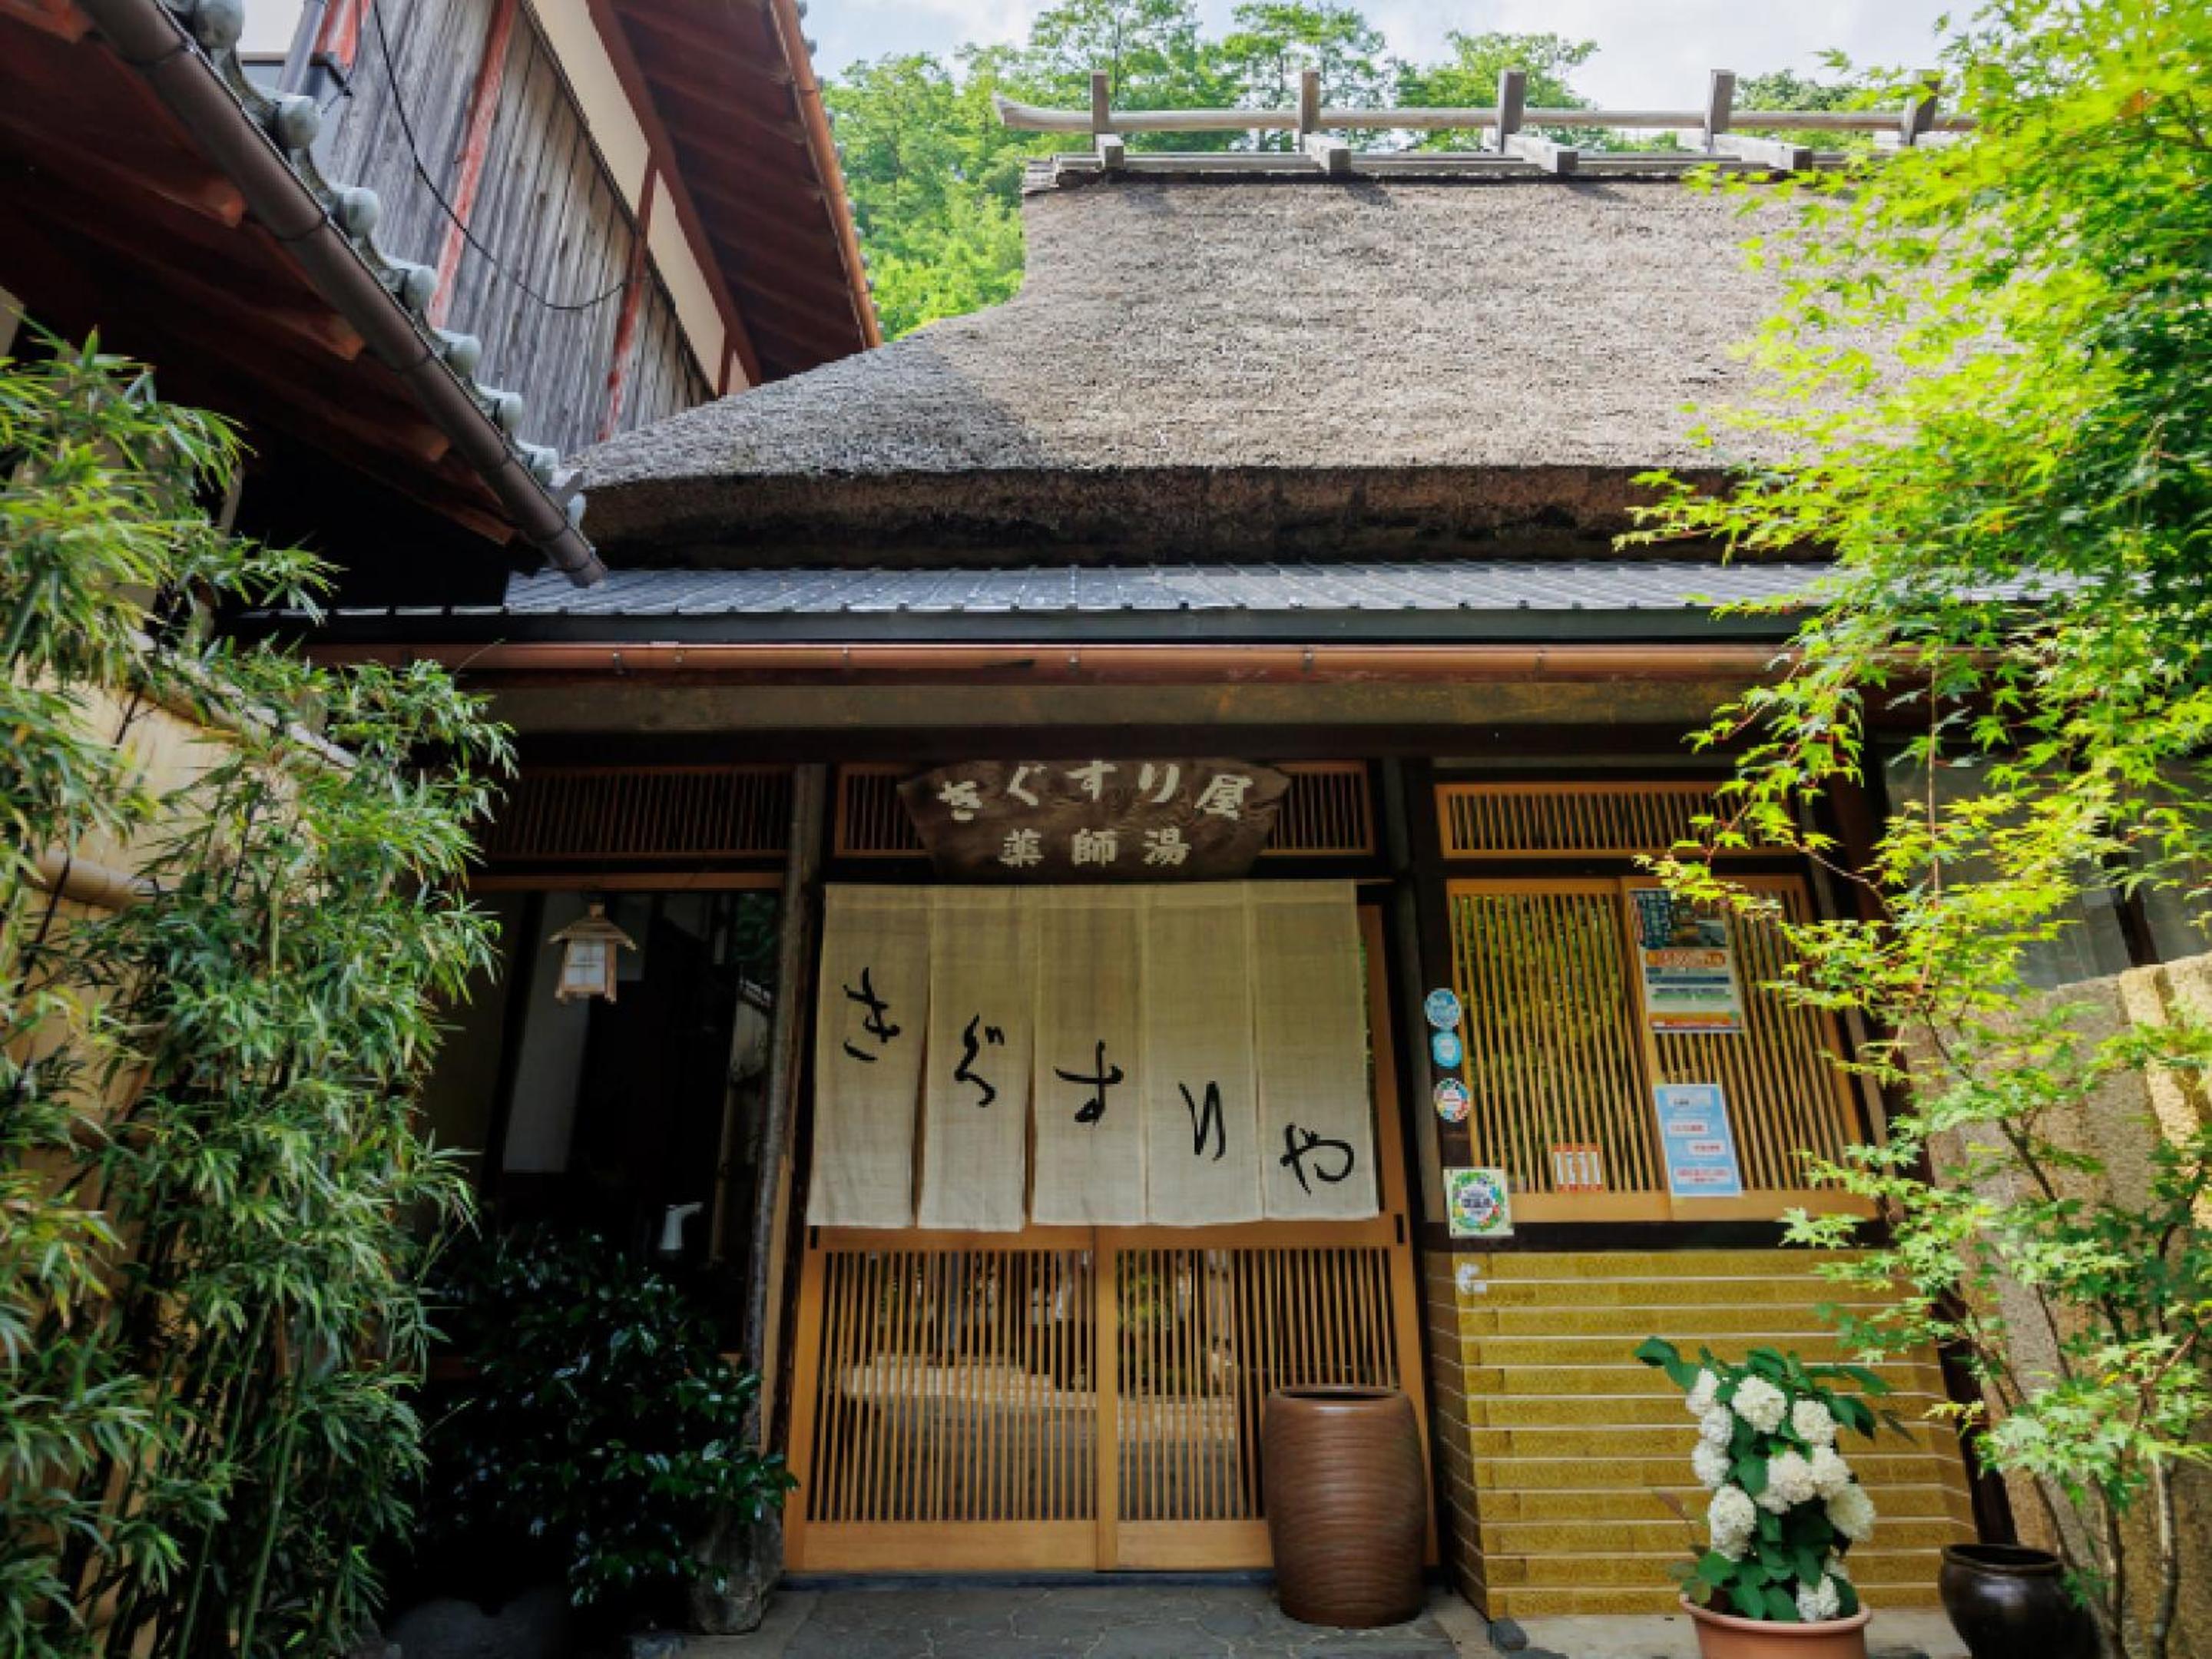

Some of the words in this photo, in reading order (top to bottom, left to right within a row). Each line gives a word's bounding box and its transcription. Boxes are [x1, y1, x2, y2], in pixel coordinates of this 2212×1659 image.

[998, 828, 1192, 868] 薬師湯
[843, 965, 1355, 1195] きぐすりや
